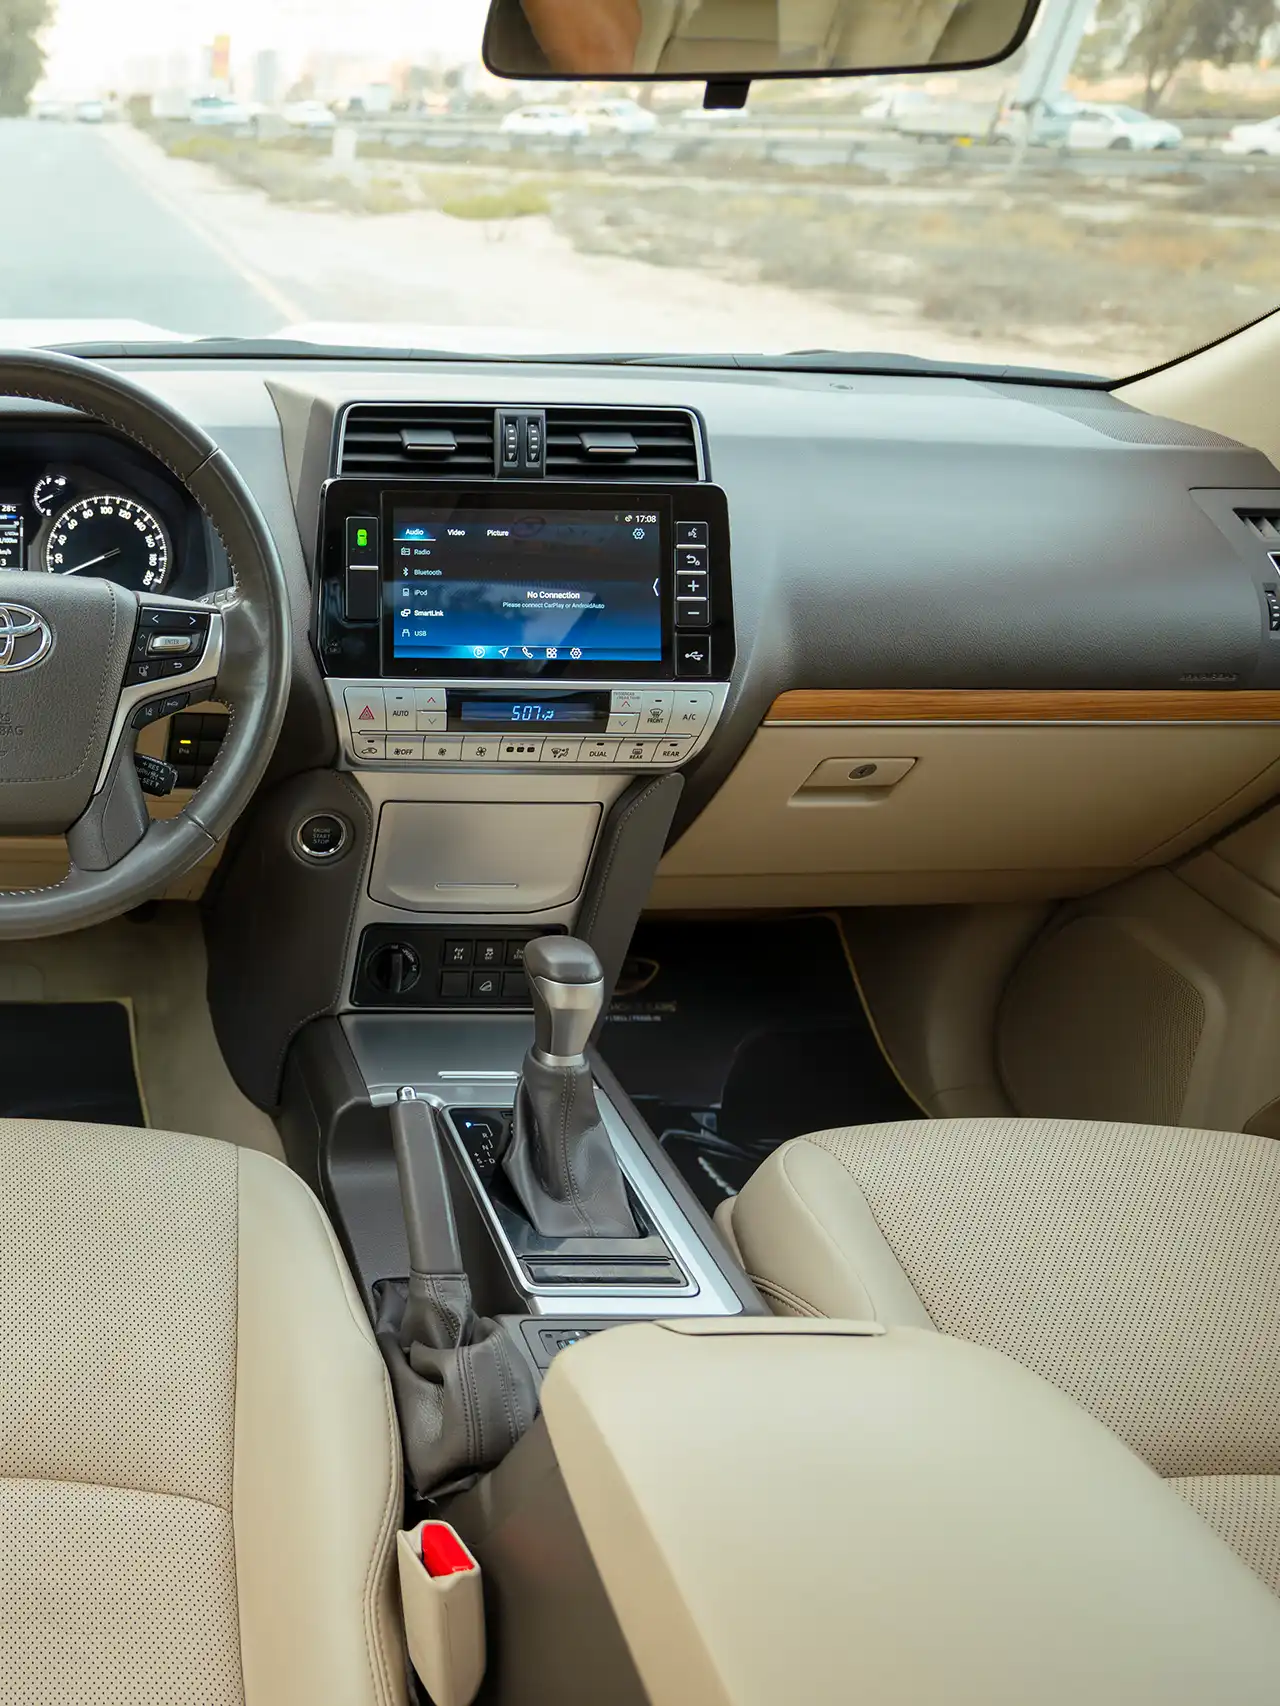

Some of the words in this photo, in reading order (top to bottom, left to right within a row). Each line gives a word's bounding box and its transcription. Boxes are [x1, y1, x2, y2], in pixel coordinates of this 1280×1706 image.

[82, 508, 94, 519] 80
[100, 506, 113, 514] 100
[118, 508, 132, 520] 120
[68, 519, 78, 530] 60
[635, 515, 656, 523] 17:08
[134, 518, 146, 532] 140
[405, 528, 424, 536] Audio
[447, 528, 466, 536] Video
[486, 528, 509, 537] Picture
[58, 534, 67, 546] 40
[145, 534, 156, 548] 160
[54, 553, 64, 564] 20
[149, 554, 157, 566] 180
[142, 570, 154, 586] 200
[527, 591, 537, 599] No
[538, 591, 580, 600] Connection
[544, 602, 564, 610] CarPlay
[414, 609, 444, 617] SmartLink
[682, 712, 696, 721] A/C
[148, 763, 160, 772] RES
